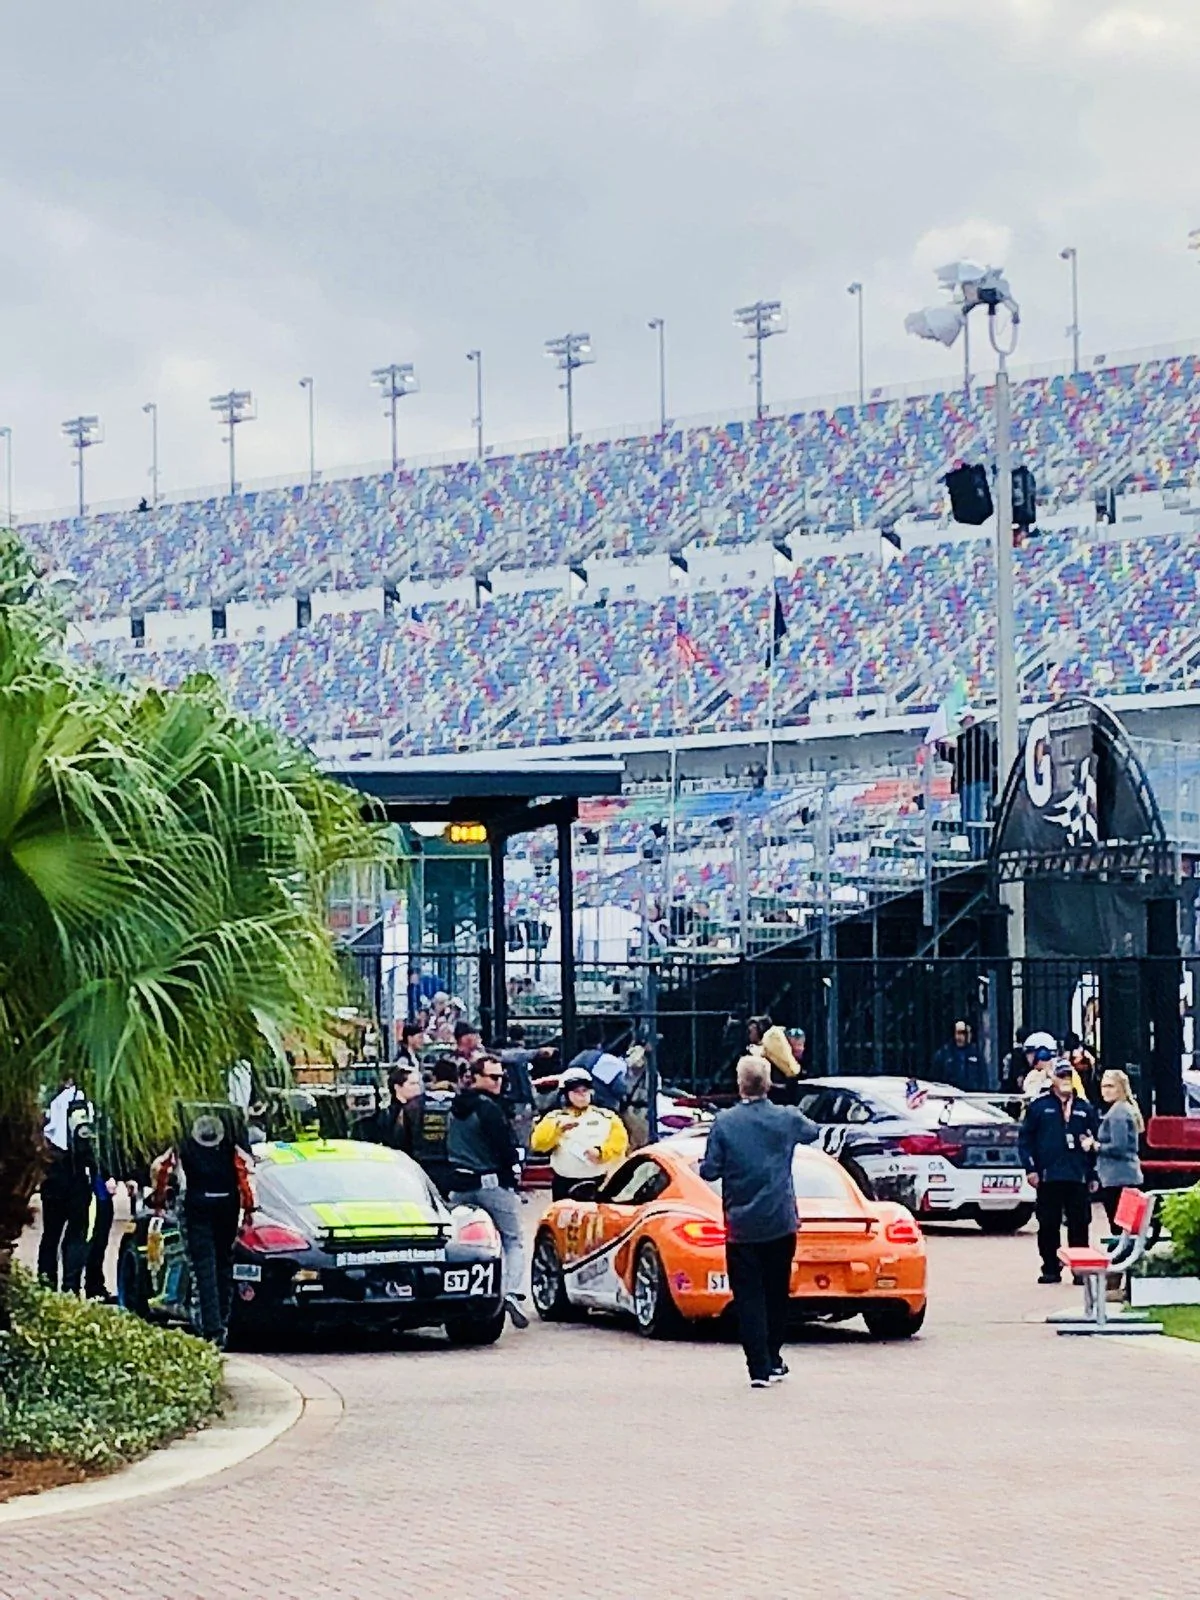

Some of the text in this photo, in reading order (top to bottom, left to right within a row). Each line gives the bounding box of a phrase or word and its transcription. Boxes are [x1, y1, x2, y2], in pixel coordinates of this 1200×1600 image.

[447, 1263, 494, 1295] ST 21
[711, 1274, 726, 1290] ST
